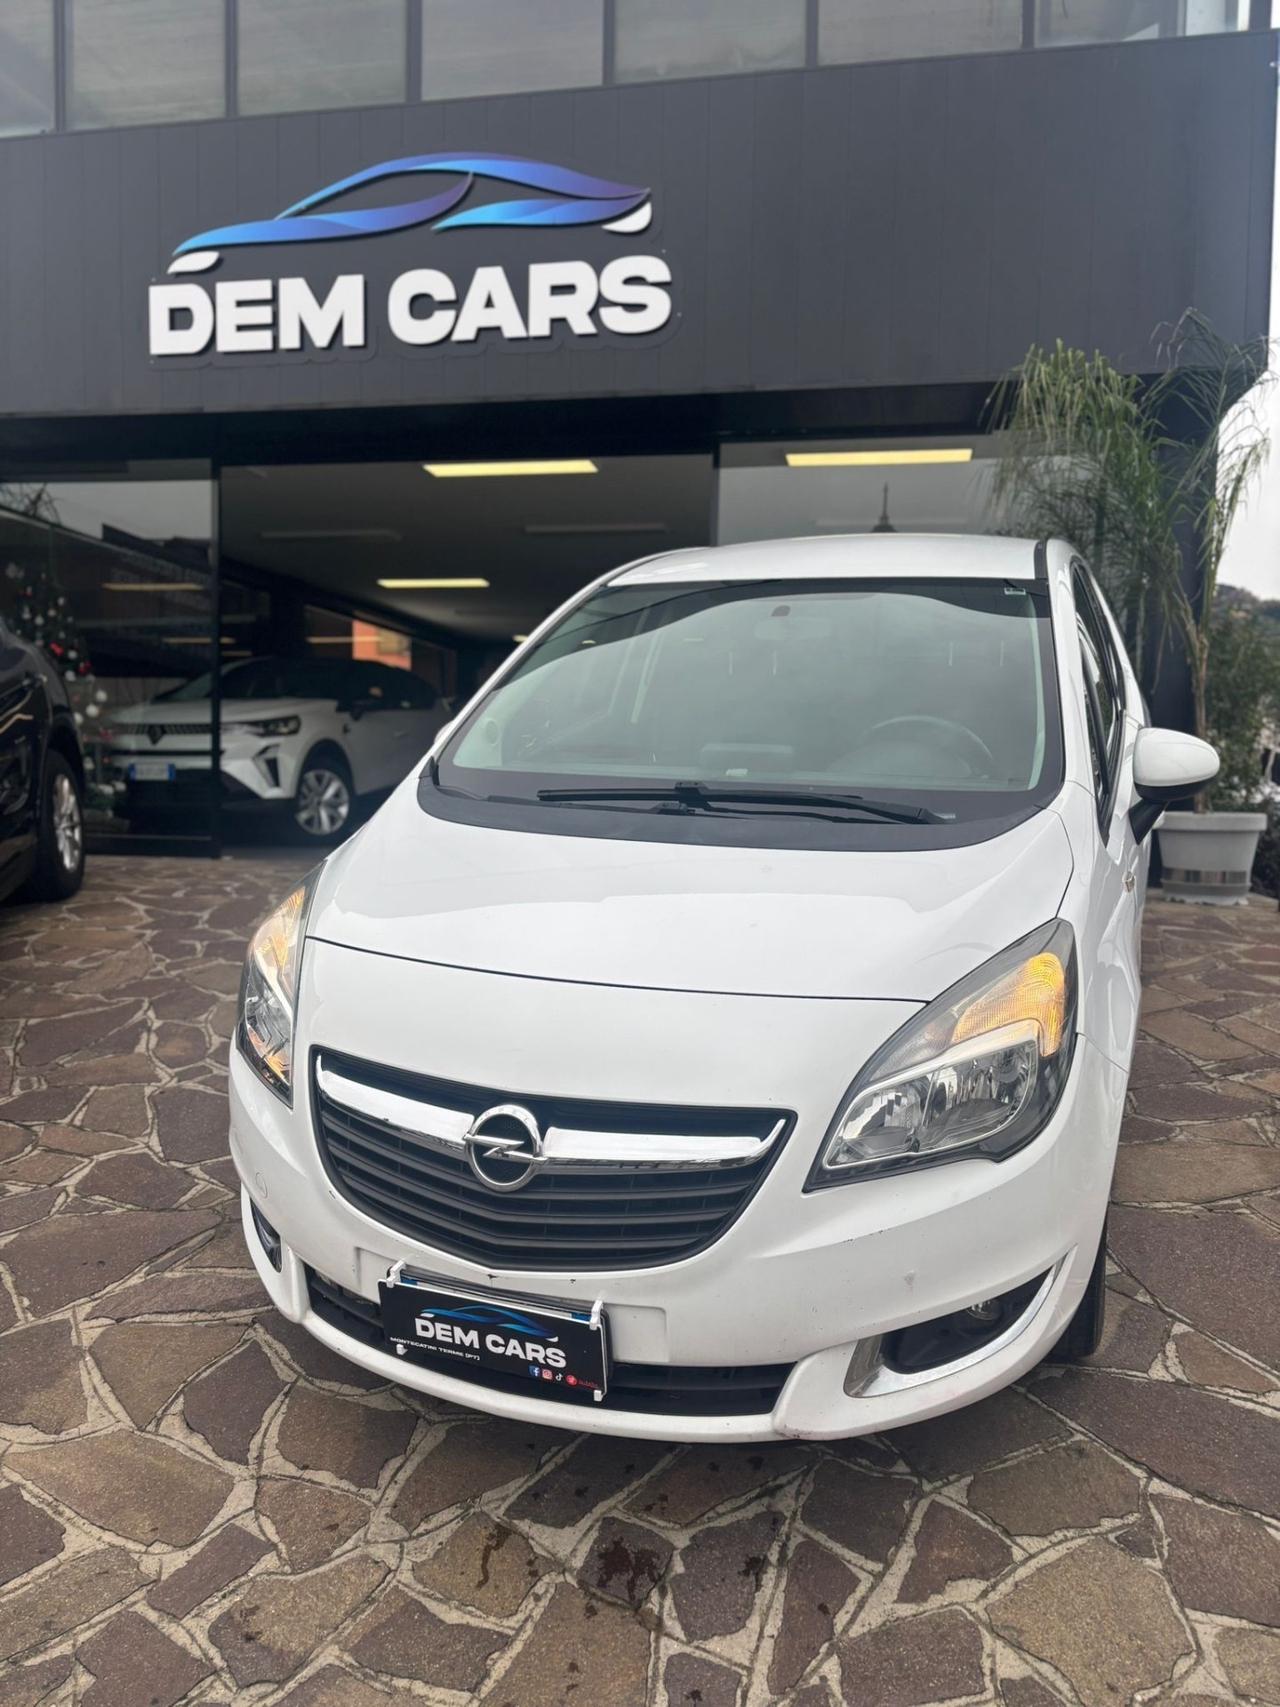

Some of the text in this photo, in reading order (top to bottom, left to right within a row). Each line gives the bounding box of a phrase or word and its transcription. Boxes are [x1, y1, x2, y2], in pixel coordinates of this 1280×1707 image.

[148, 255, 672, 355] DEM CARS
[414, 1317, 567, 1368] DEM CARS
